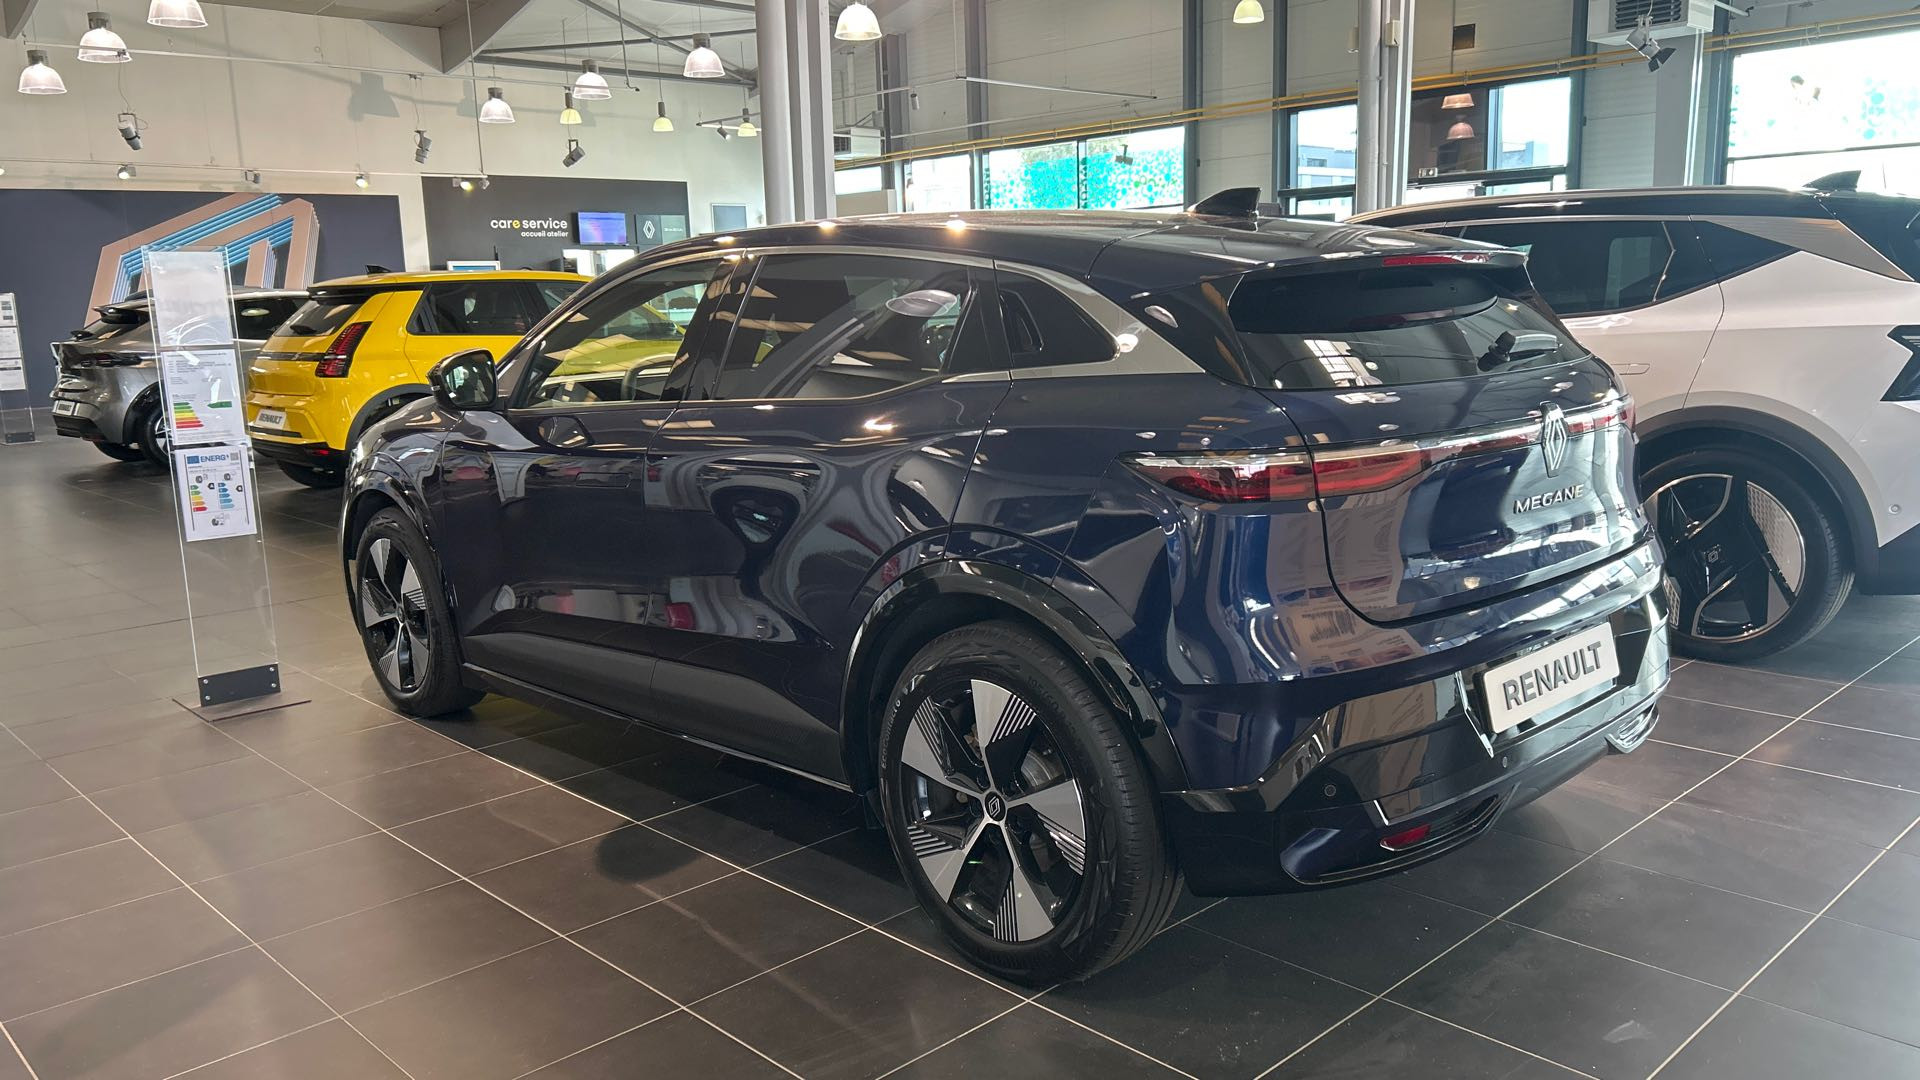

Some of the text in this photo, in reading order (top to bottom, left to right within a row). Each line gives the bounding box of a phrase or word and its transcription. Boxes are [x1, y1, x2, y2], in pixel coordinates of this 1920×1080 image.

[490, 217, 568, 229] care service
[521, 230, 569, 238] accueil atelier
[1513, 483, 1585, 514] MEGANE
[1502, 640, 1602, 711] RENAULT
